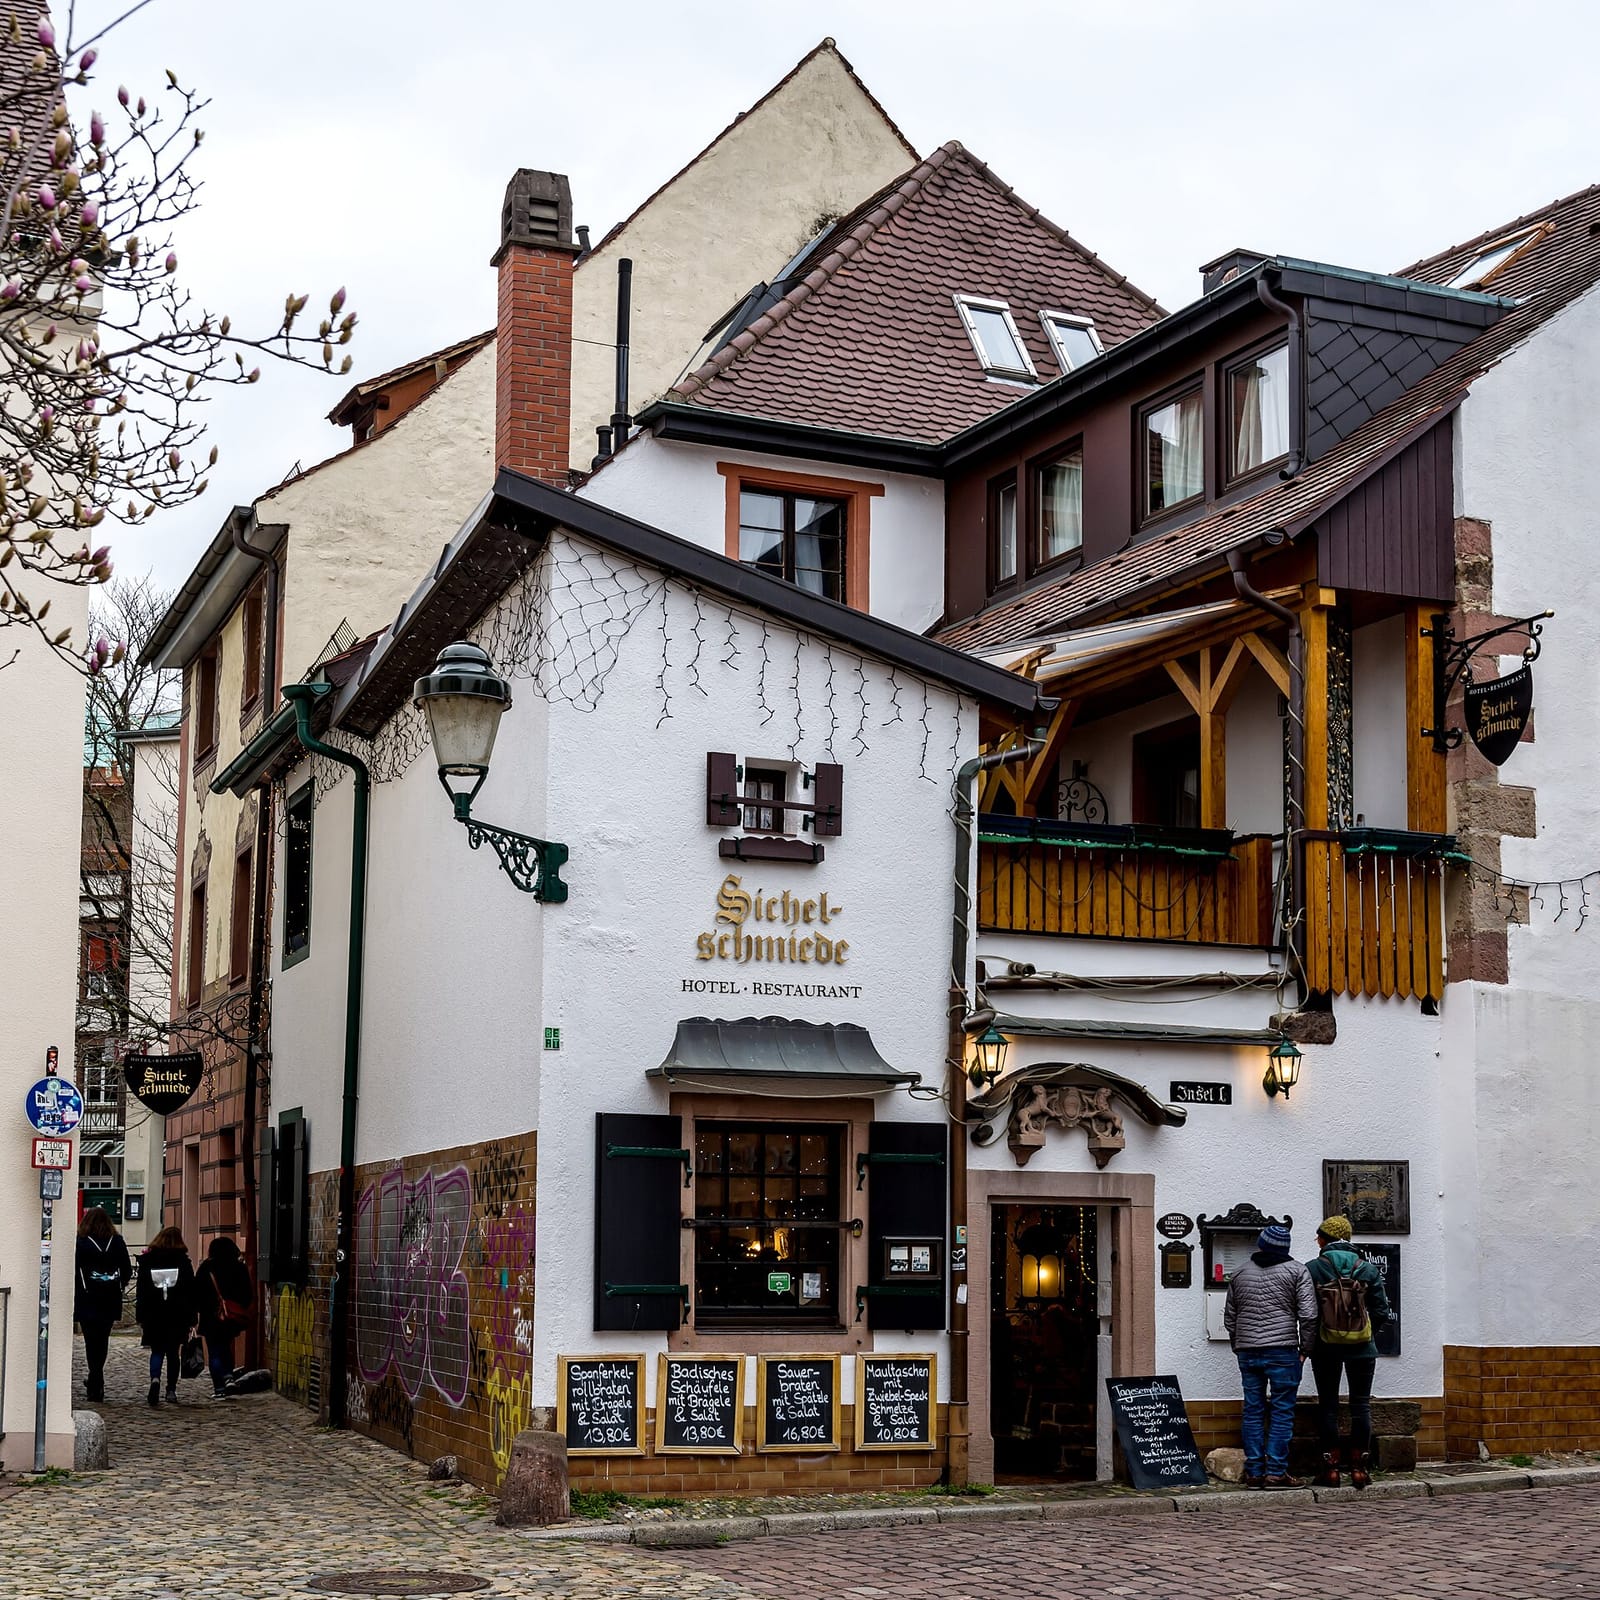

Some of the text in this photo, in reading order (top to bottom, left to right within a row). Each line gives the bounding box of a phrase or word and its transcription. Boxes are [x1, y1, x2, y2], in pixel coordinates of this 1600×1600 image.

[716, 874, 843, 926] Sichel-
[696, 925, 850, 965] schmiede
[681, 979, 862, 998] HOTEL RESTAURANT
[144, 1067, 187, 1083] Sichel-
[139, 1082, 191, 1097] schmiede
[1177, 1085, 1213, 1101] Insel
[670, 1363, 734, 1381] Badisches
[777, 1363, 820, 1378] Sauer-
[866, 1362, 928, 1379] Maultaschen
[572, 1380, 631, 1397] rollbraten
[670, 1379, 730, 1397] Schäufele
[779, 1378, 820, 1392] braten
[883, 1377, 903, 1389] mit
[571, 1397, 591, 1411] mit
[668, 1393, 731, 1413] mit Brägele
[772, 1392, 791, 1406] mit
[674, 1406, 720, 1422] & Salat
[775, 1405, 820, 1420] & Salat
[869, 1402, 916, 1415] Schmelze
[578, 1411, 625, 1425] & Salat
[873, 1412, 920, 1426] & Salat
[584, 1427, 631, 1443] 13,80€
[682, 1425, 726, 1443] 13,80€
[783, 1425, 826, 1441] 16,80€
[877, 1427, 919, 1441] 10,80€
[1160, 1464, 1190, 1475] 10,80€
